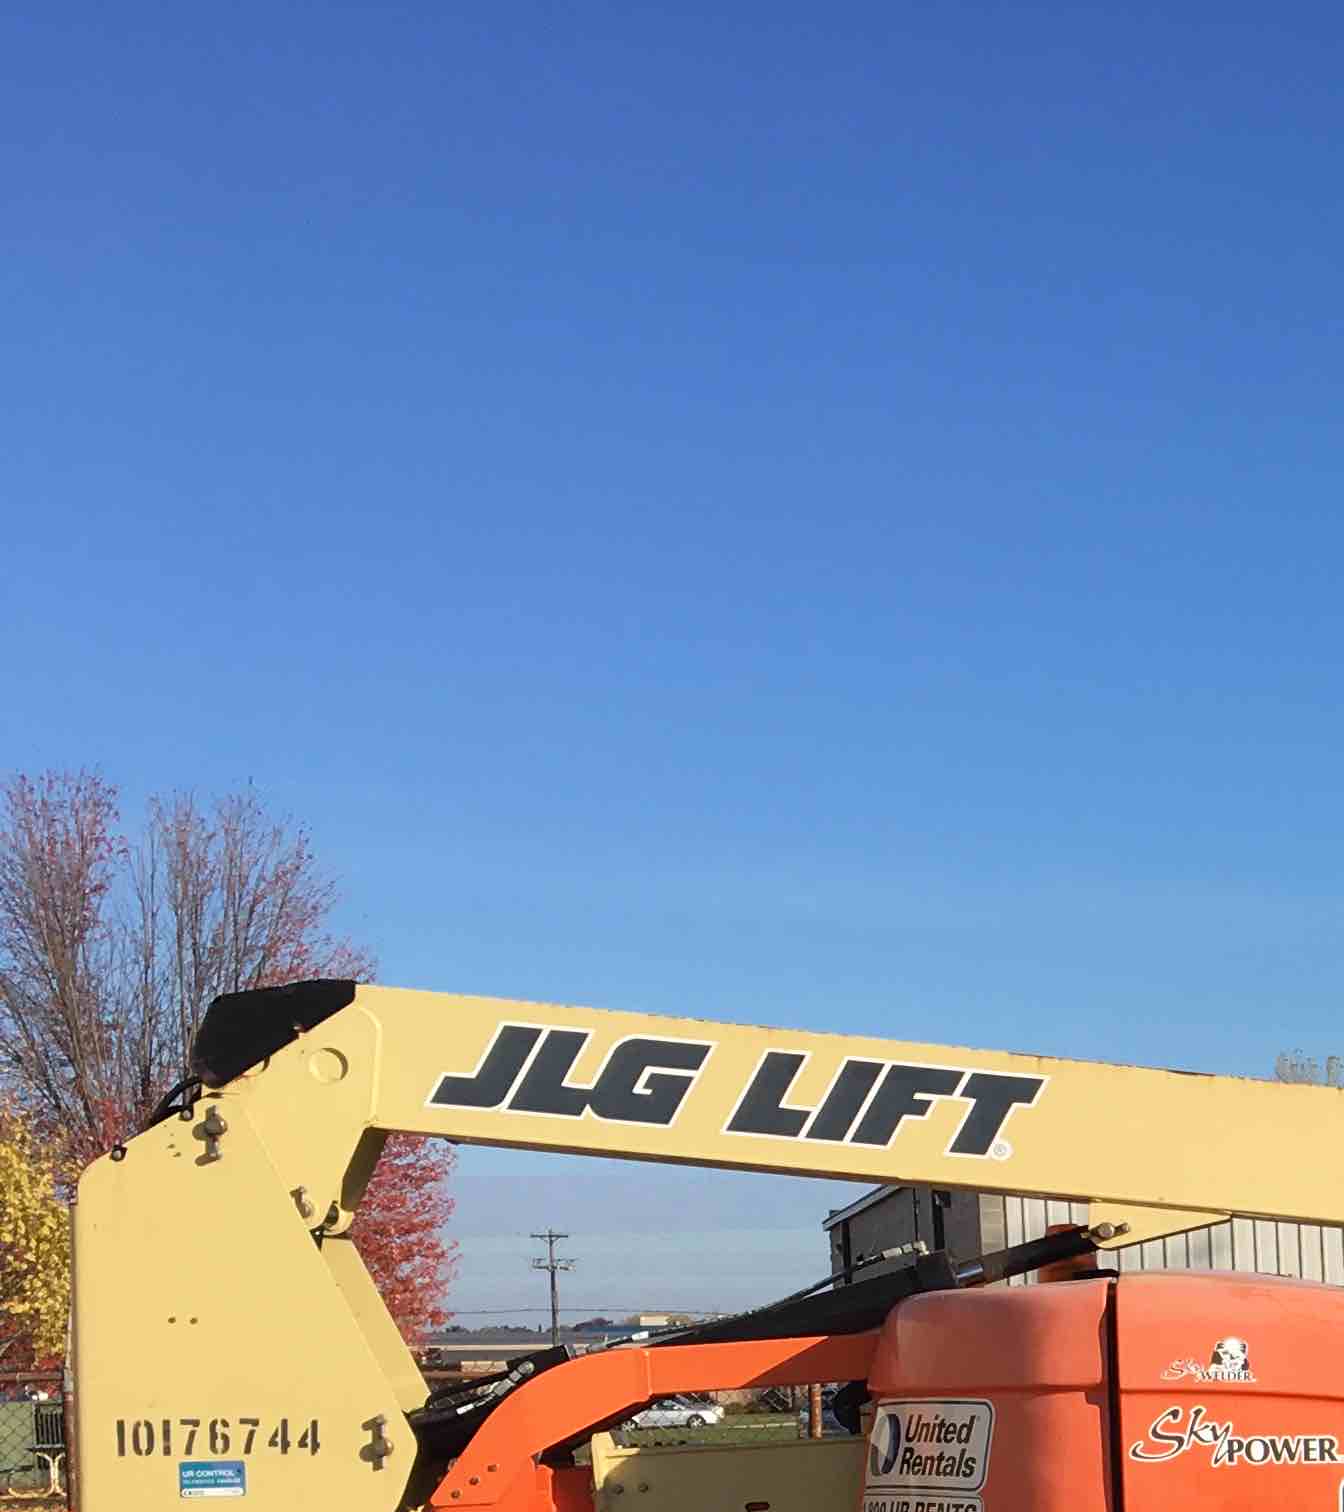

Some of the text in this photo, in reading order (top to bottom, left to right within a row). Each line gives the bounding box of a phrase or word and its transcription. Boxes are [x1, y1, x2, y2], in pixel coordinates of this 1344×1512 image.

[427, 1023, 1050, 1158] JLG LIFT
[116, 1418, 321, 1457] 10176744
[905, 1414, 976, 1444] United
[900, 1446, 977, 1478] Rentals
